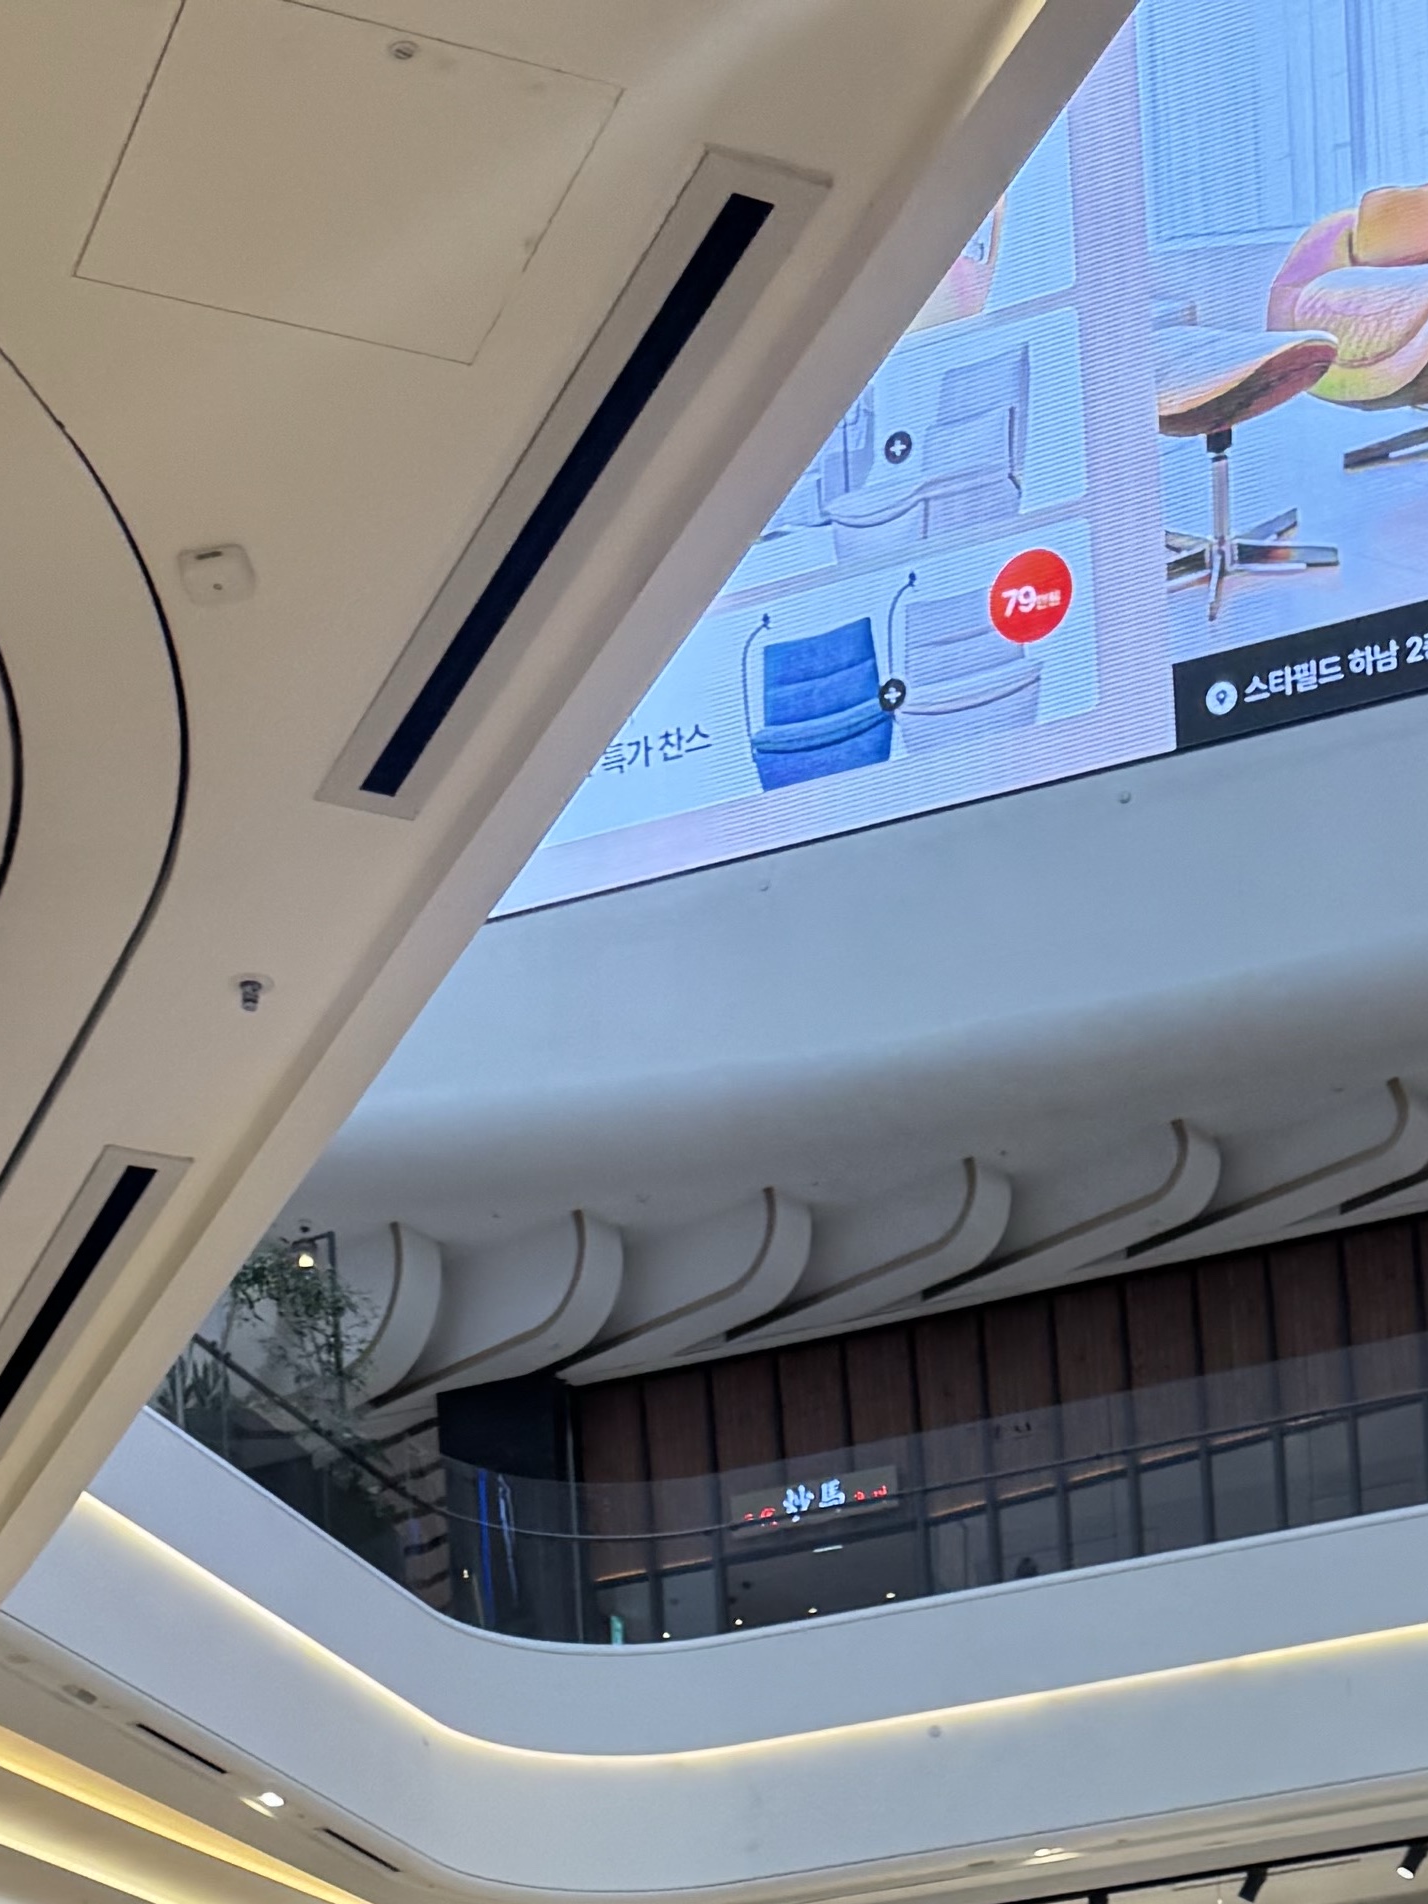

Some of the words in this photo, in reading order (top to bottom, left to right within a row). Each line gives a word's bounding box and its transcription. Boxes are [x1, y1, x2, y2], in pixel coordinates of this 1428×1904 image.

[1243, 656, 1345, 704] 스타필드
[1347, 638, 1400, 677] 하남
[658, 723, 713, 763] 찬스
